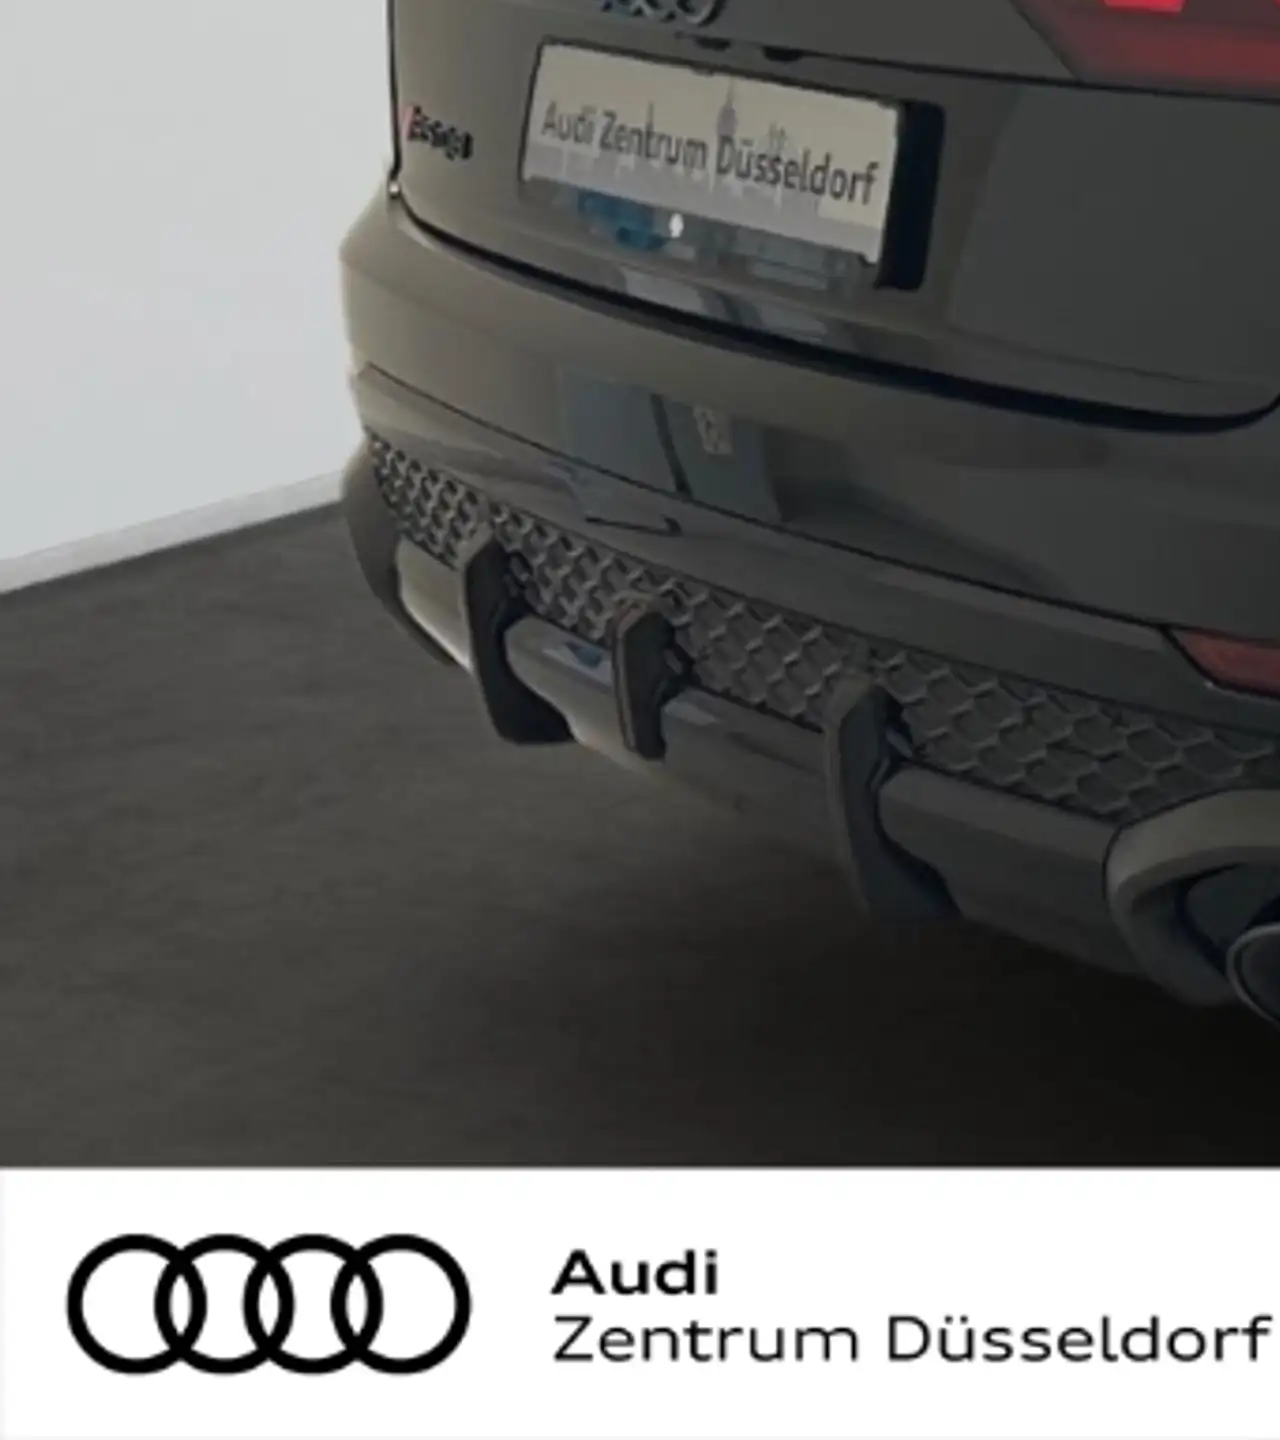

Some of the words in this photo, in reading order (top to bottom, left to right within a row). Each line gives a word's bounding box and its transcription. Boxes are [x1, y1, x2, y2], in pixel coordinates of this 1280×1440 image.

[541, 101, 597, 145] Audi
[600, 110, 708, 171] Zentrum
[715, 134, 880, 205] Düsseldorf
